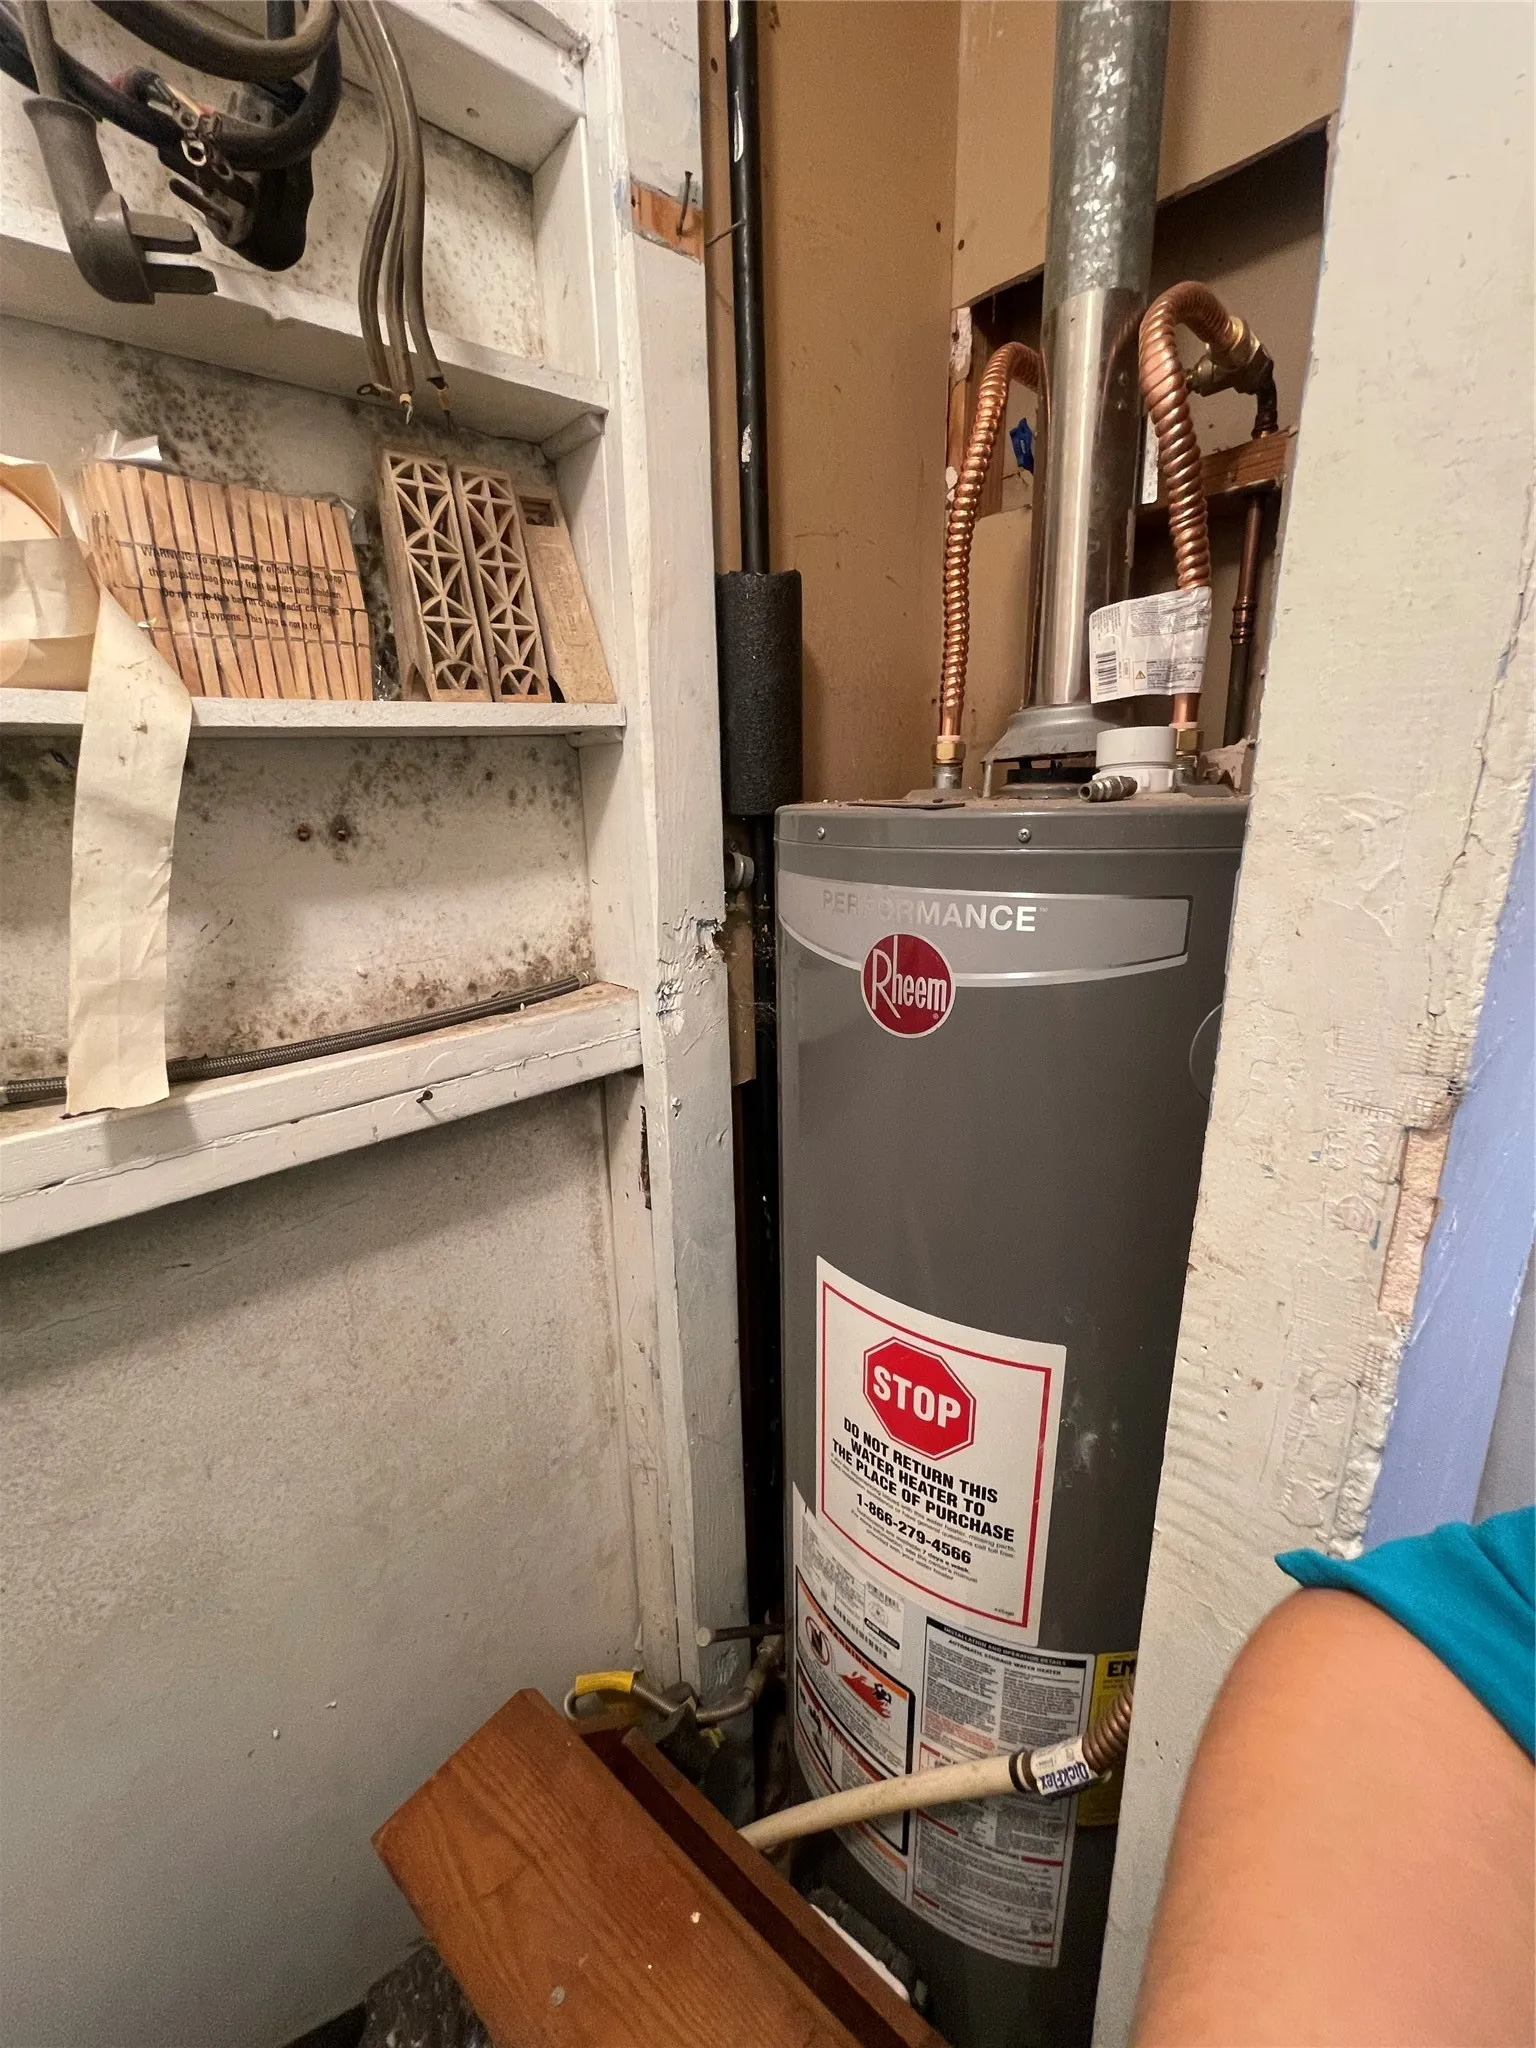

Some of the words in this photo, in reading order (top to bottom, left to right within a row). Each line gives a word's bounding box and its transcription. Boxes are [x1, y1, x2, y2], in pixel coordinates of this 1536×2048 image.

[149, 567, 166, 578] this
[170, 568, 201, 580] plastic
[203, 573, 218, 585] bag
[221, 577, 242, 588] away
[245, 579, 264, 590] from
[266, 582, 293, 593] babies
[295, 586, 310, 595] and
[163, 587, 174, 597] Do
[178, 590, 192, 598] not
[194, 592, 210, 601] use
[201, 611, 244, 621] playpens.
[266, 618, 278, 627] bag
[289, 620, 300, 629] not
[822, 889, 1037, 932] PERFORMANCE
[871, 935, 947, 1019] Rheem
[873, 1365, 961, 1428] STOP
[832, 1438, 853, 1466] THE
[856, 1458, 897, 1496] PLACE
[901, 1488, 920, 1507] OF
[925, 1500, 1014, 1542] PURCHASE
[844, 1417, 859, 1439] DO
[863, 1431, 889, 1457] NOT
[893, 1449, 953, 1490] RETURN
[959, 1479, 998, 1503] THIS
[851, 1438, 894, 1478] WATER
[899, 1469, 957, 1508] HEATER
[963, 1498, 985, 1517] TO
[857, 1493, 972, 1564] 1-866-279-4566
